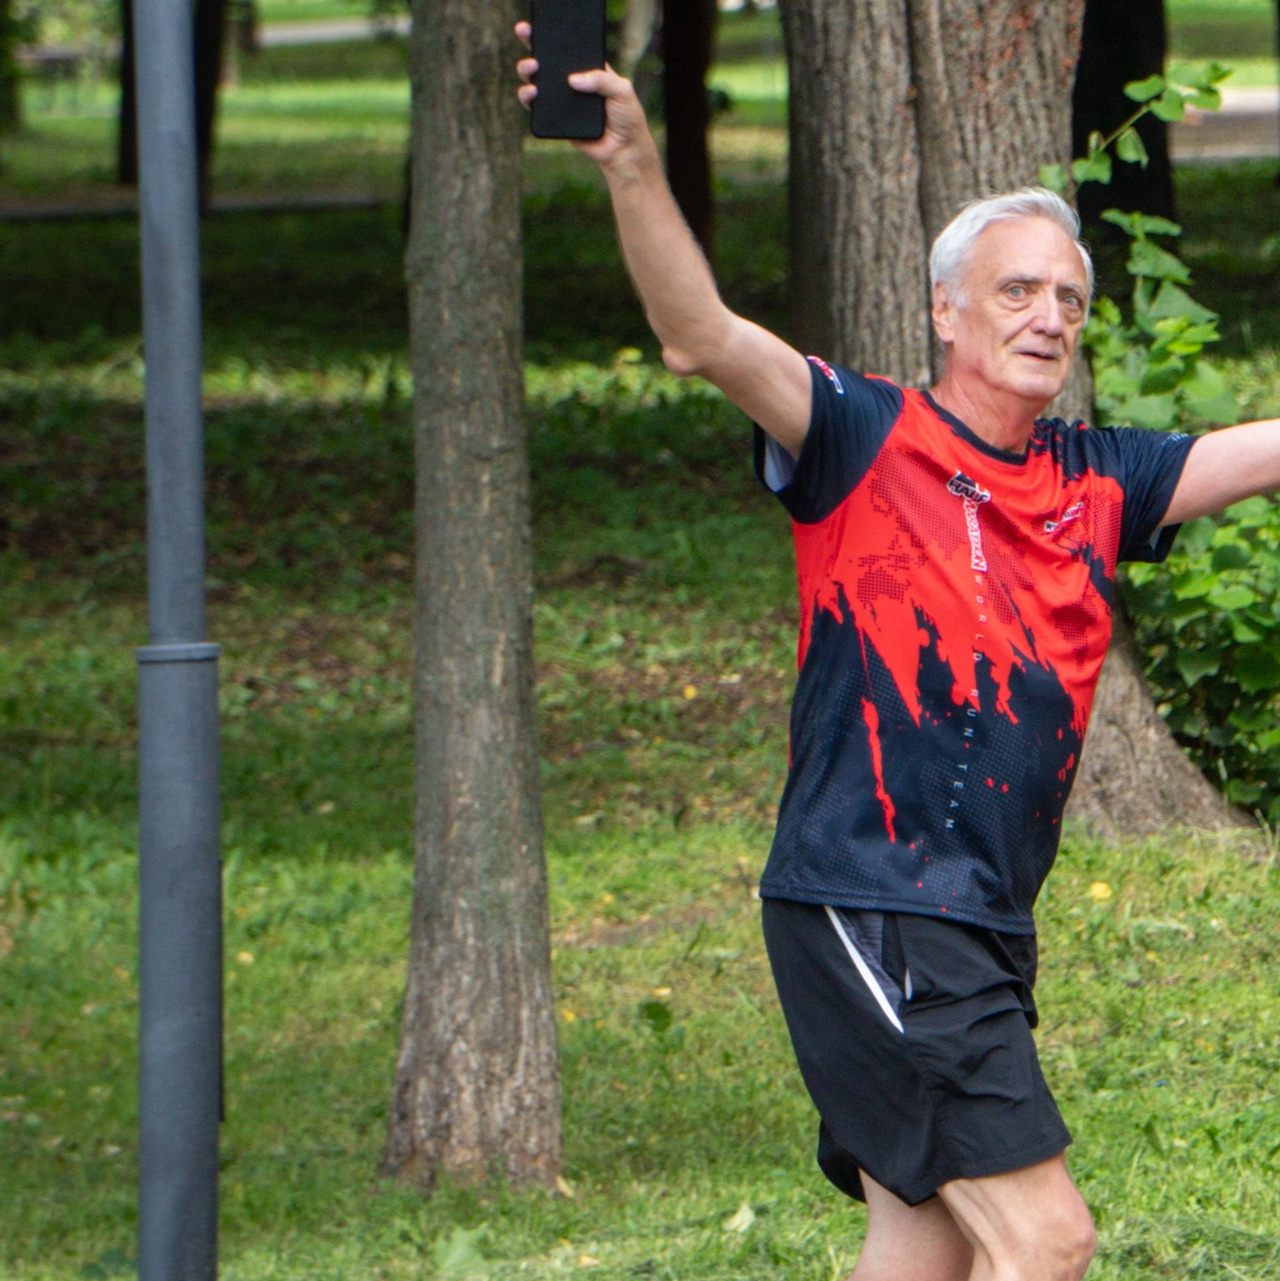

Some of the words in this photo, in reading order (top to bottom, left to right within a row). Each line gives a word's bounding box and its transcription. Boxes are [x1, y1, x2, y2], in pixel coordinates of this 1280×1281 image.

[946, 478, 989, 503] HALF
[973, 575, 987, 662] WORLD
[963, 688, 979, 738] RUN
[945, 763, 968, 829] TEAM
